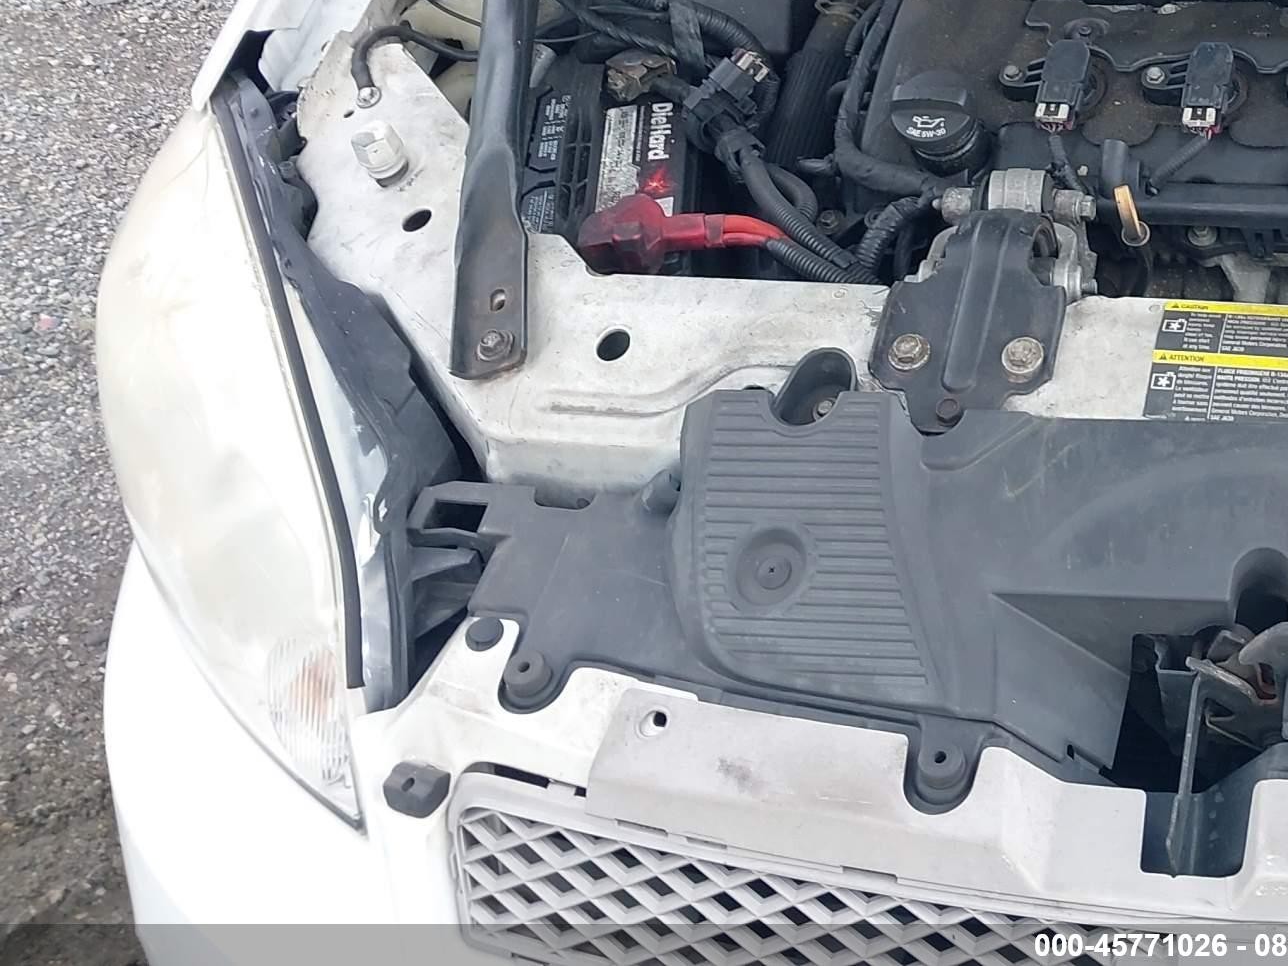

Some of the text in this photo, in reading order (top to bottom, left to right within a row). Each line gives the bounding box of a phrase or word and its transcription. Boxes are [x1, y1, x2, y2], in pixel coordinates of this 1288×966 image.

[648, 103, 673, 160] DieHard
[907, 127, 946, 138] SAE 5W-30
